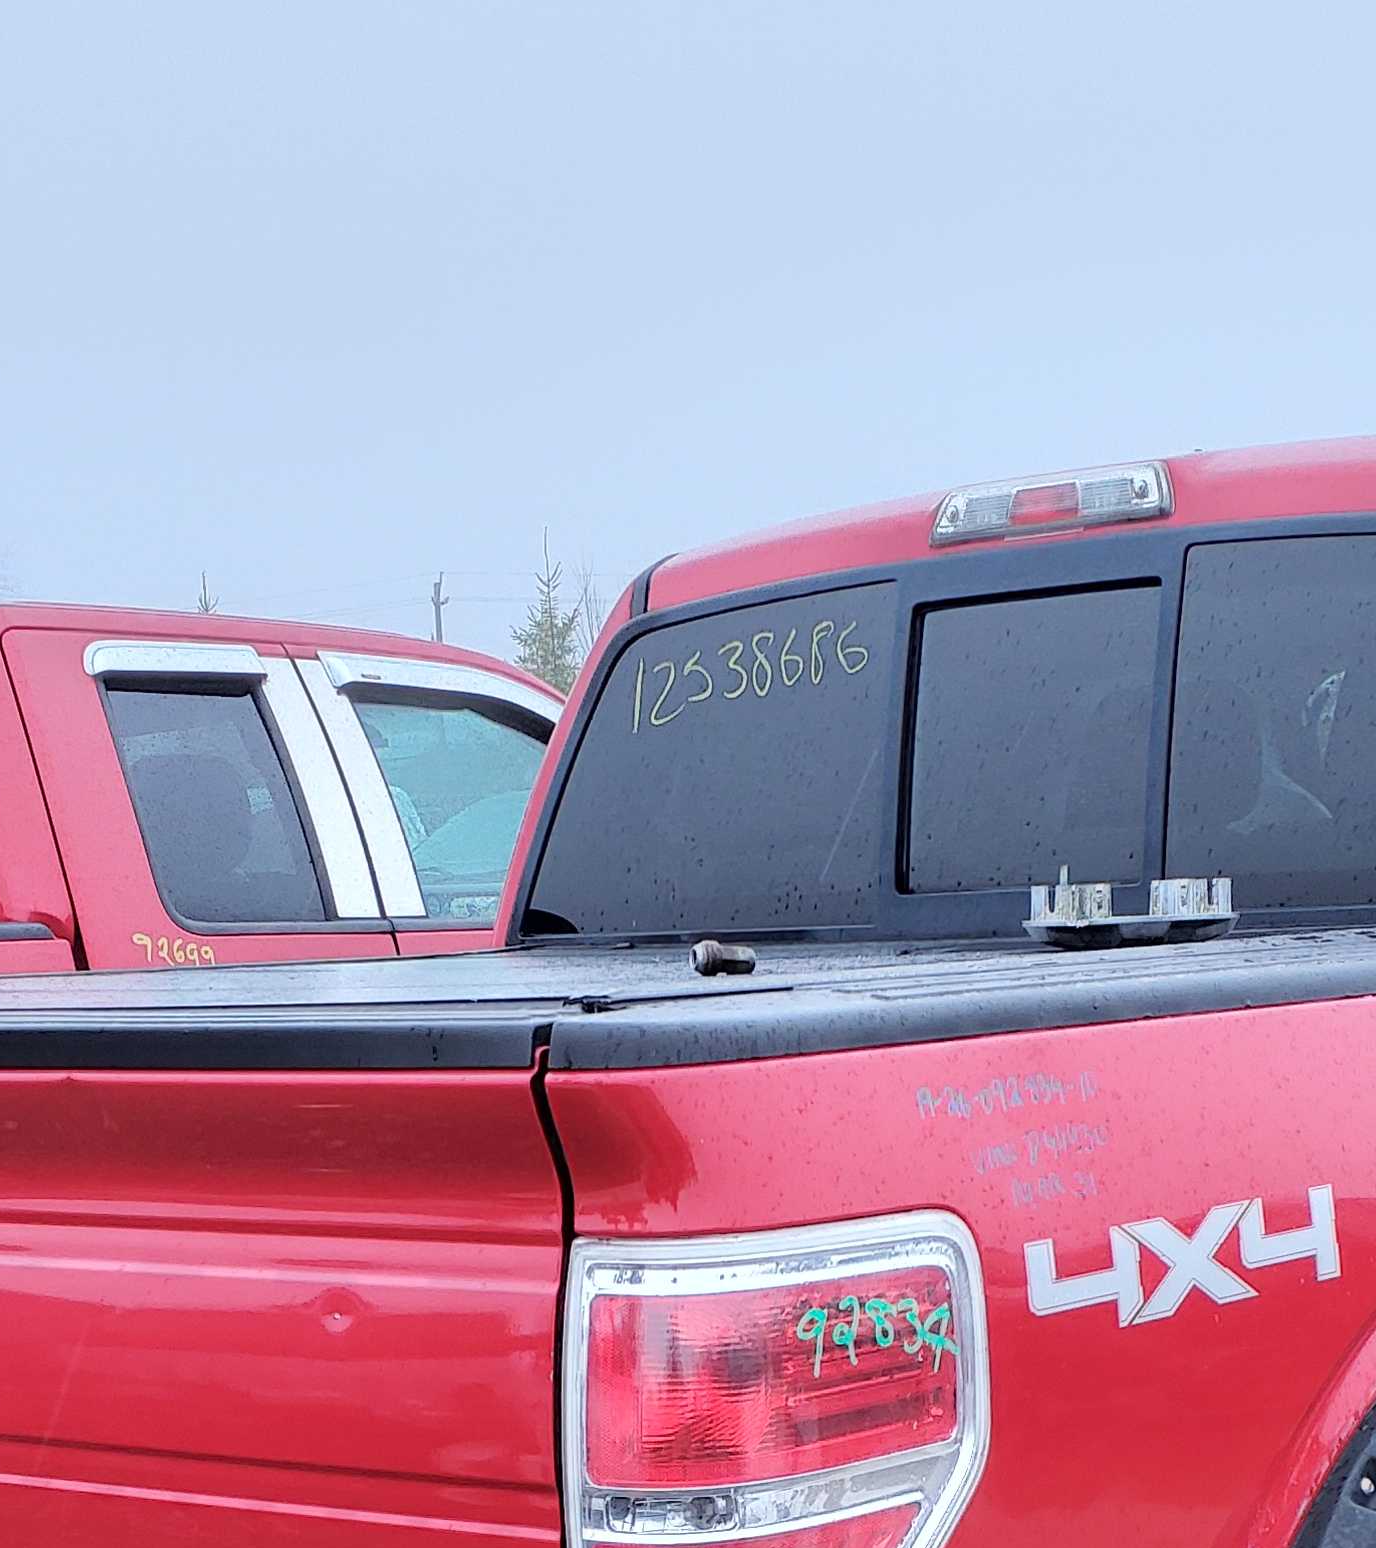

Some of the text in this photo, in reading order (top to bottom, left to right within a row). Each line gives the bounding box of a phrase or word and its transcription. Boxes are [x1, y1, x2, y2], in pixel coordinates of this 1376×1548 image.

[632, 620, 870, 735] 12538686
[1024, 1183, 1342, 1328] 4X4
[795, 1296, 960, 1378] 92834
